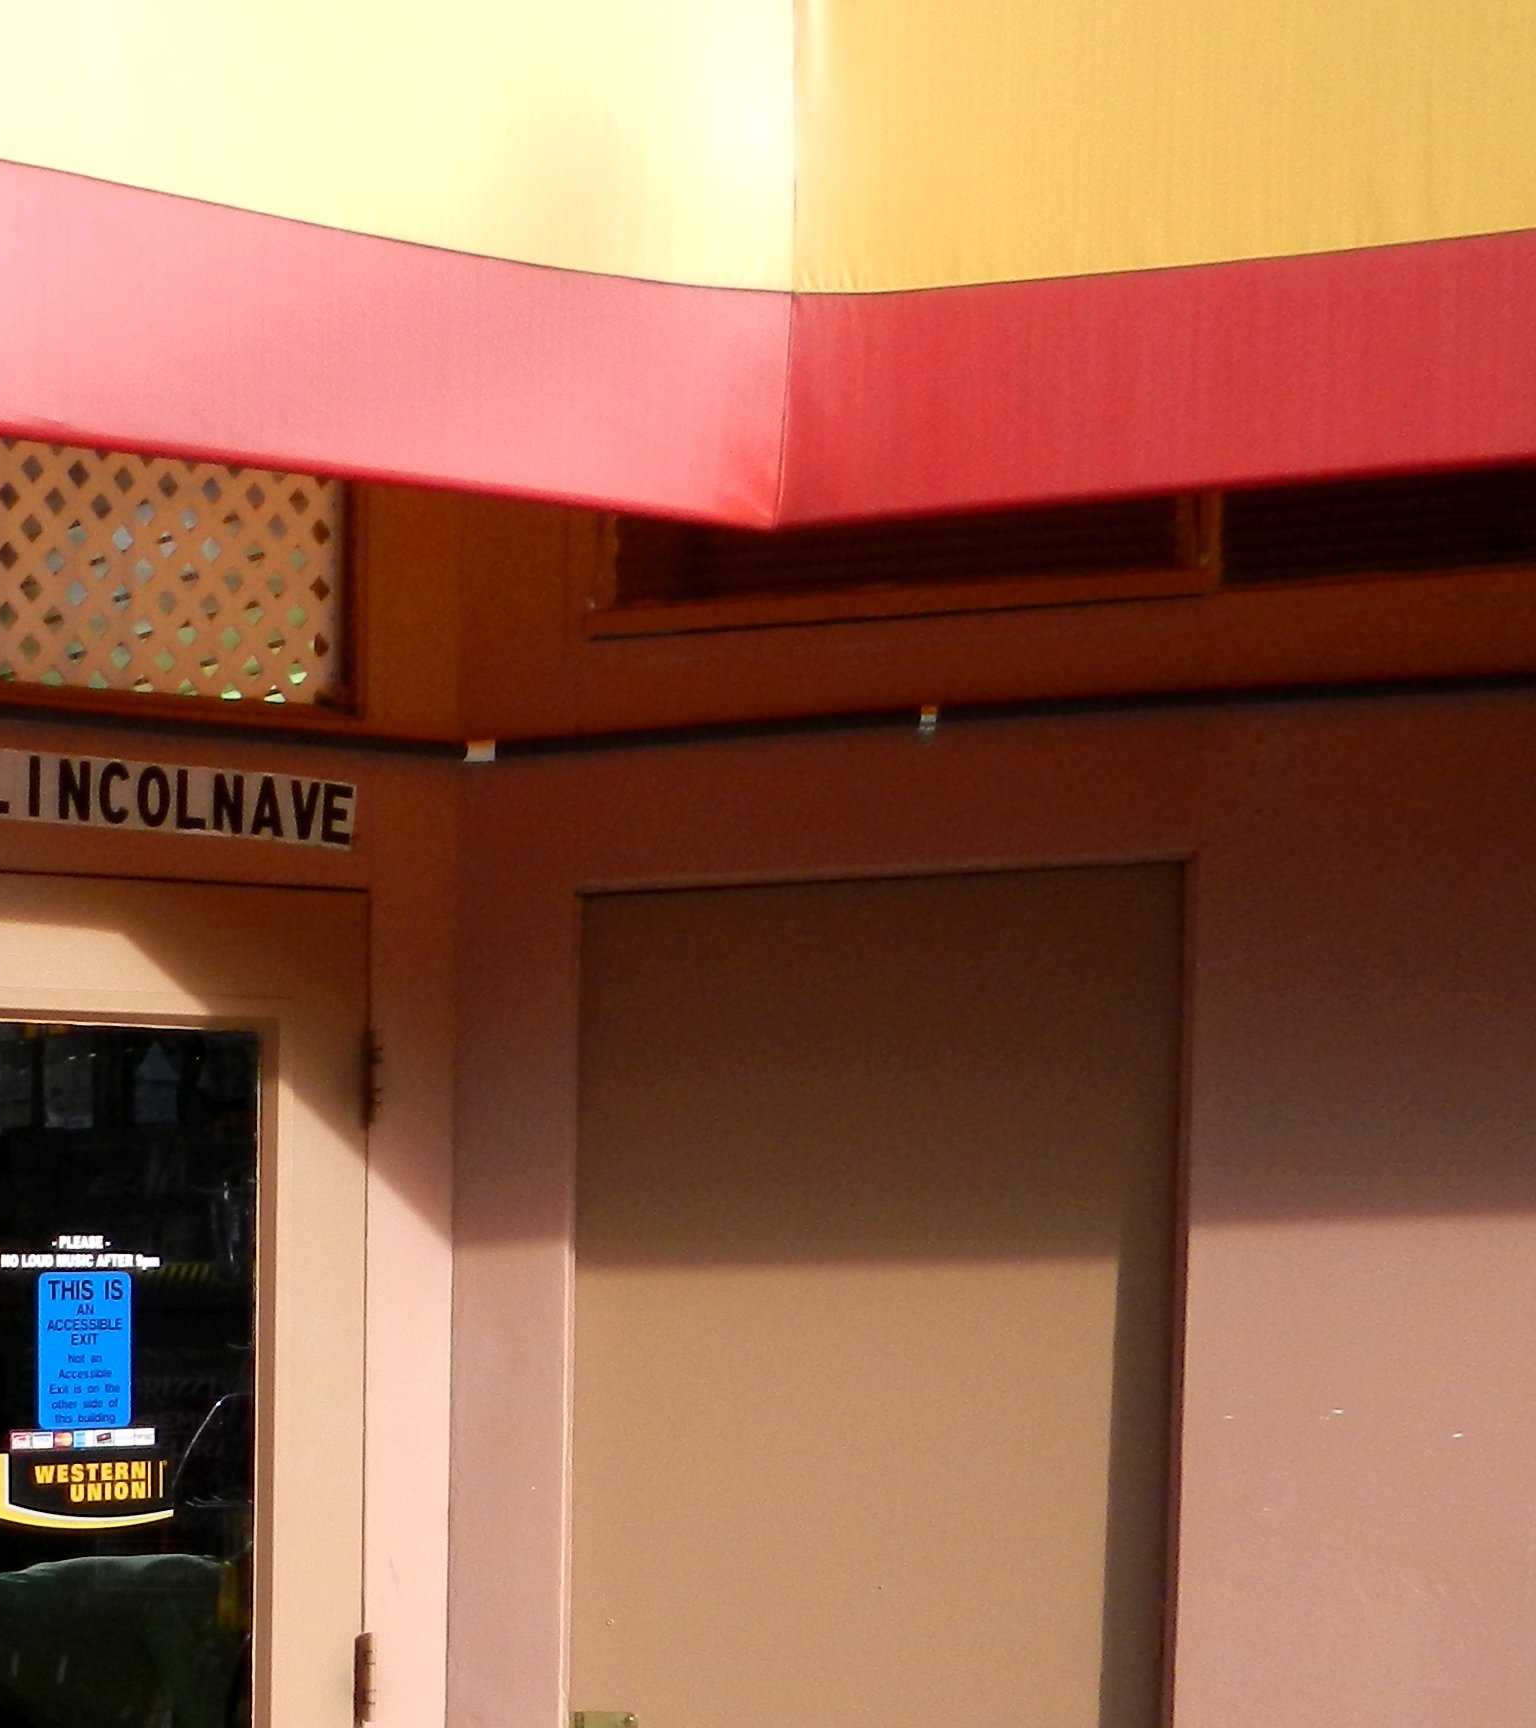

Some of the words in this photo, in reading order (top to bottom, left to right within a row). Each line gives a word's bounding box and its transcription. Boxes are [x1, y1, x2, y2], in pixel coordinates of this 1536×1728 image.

[58, 1235, 104, 1249] PLEASE
[0, 1254, 19, 1268] NO
[96, 1254, 134, 1268] AFTER
[48, 1280, 93, 1300] THIS
[104, 1280, 123, 1300] IS
[76, 1305, 94, 1315] AN
[47, 1318, 122, 1331] ACCESSIBLE
[70, 1333, 99, 1345] EXIT
[58, 1369, 112, 1379] Accessible
[49, 1384, 68, 1394] Exit
[74, 1384, 82, 1394] is
[105, 1383, 120, 1394] the
[51, 1400, 77, 1410] other
[83, 1399, 103, 1409] side
[108, 1398, 119, 1408] of
[54, 1413, 73, 1424] this
[78, 1412, 117, 1424] building
[34, 1461, 146, 1484] WESTERN
[70, 1481, 146, 1503] UNION
